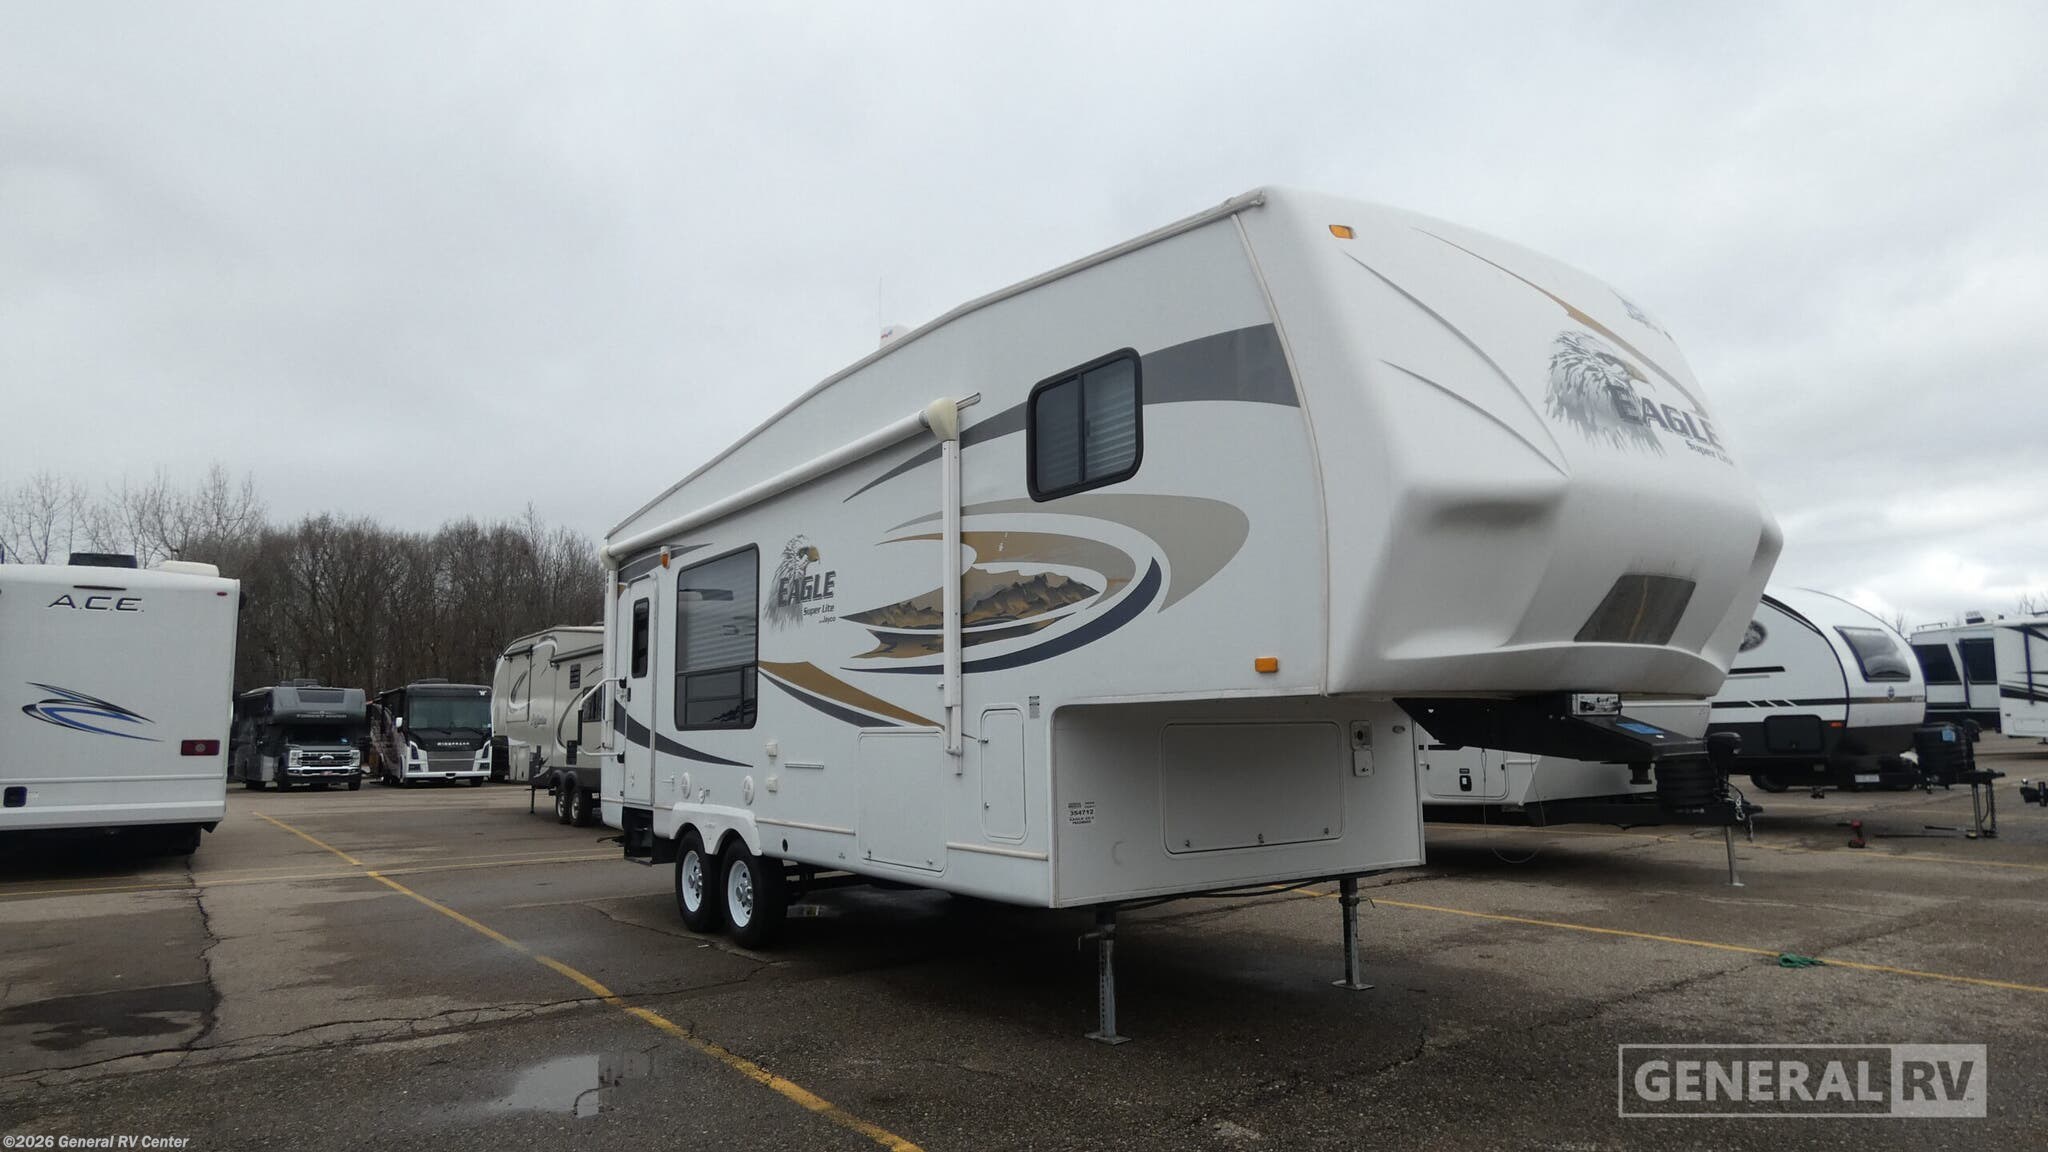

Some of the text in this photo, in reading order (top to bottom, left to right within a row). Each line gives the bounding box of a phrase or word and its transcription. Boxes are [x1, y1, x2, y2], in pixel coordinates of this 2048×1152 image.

[1606, 384, 1726, 453] EAGLE
[777, 570, 836, 607] EAGLE
[47, 594, 145, 613] A.C.E.
[802, 603, 835, 617] Super Lite
